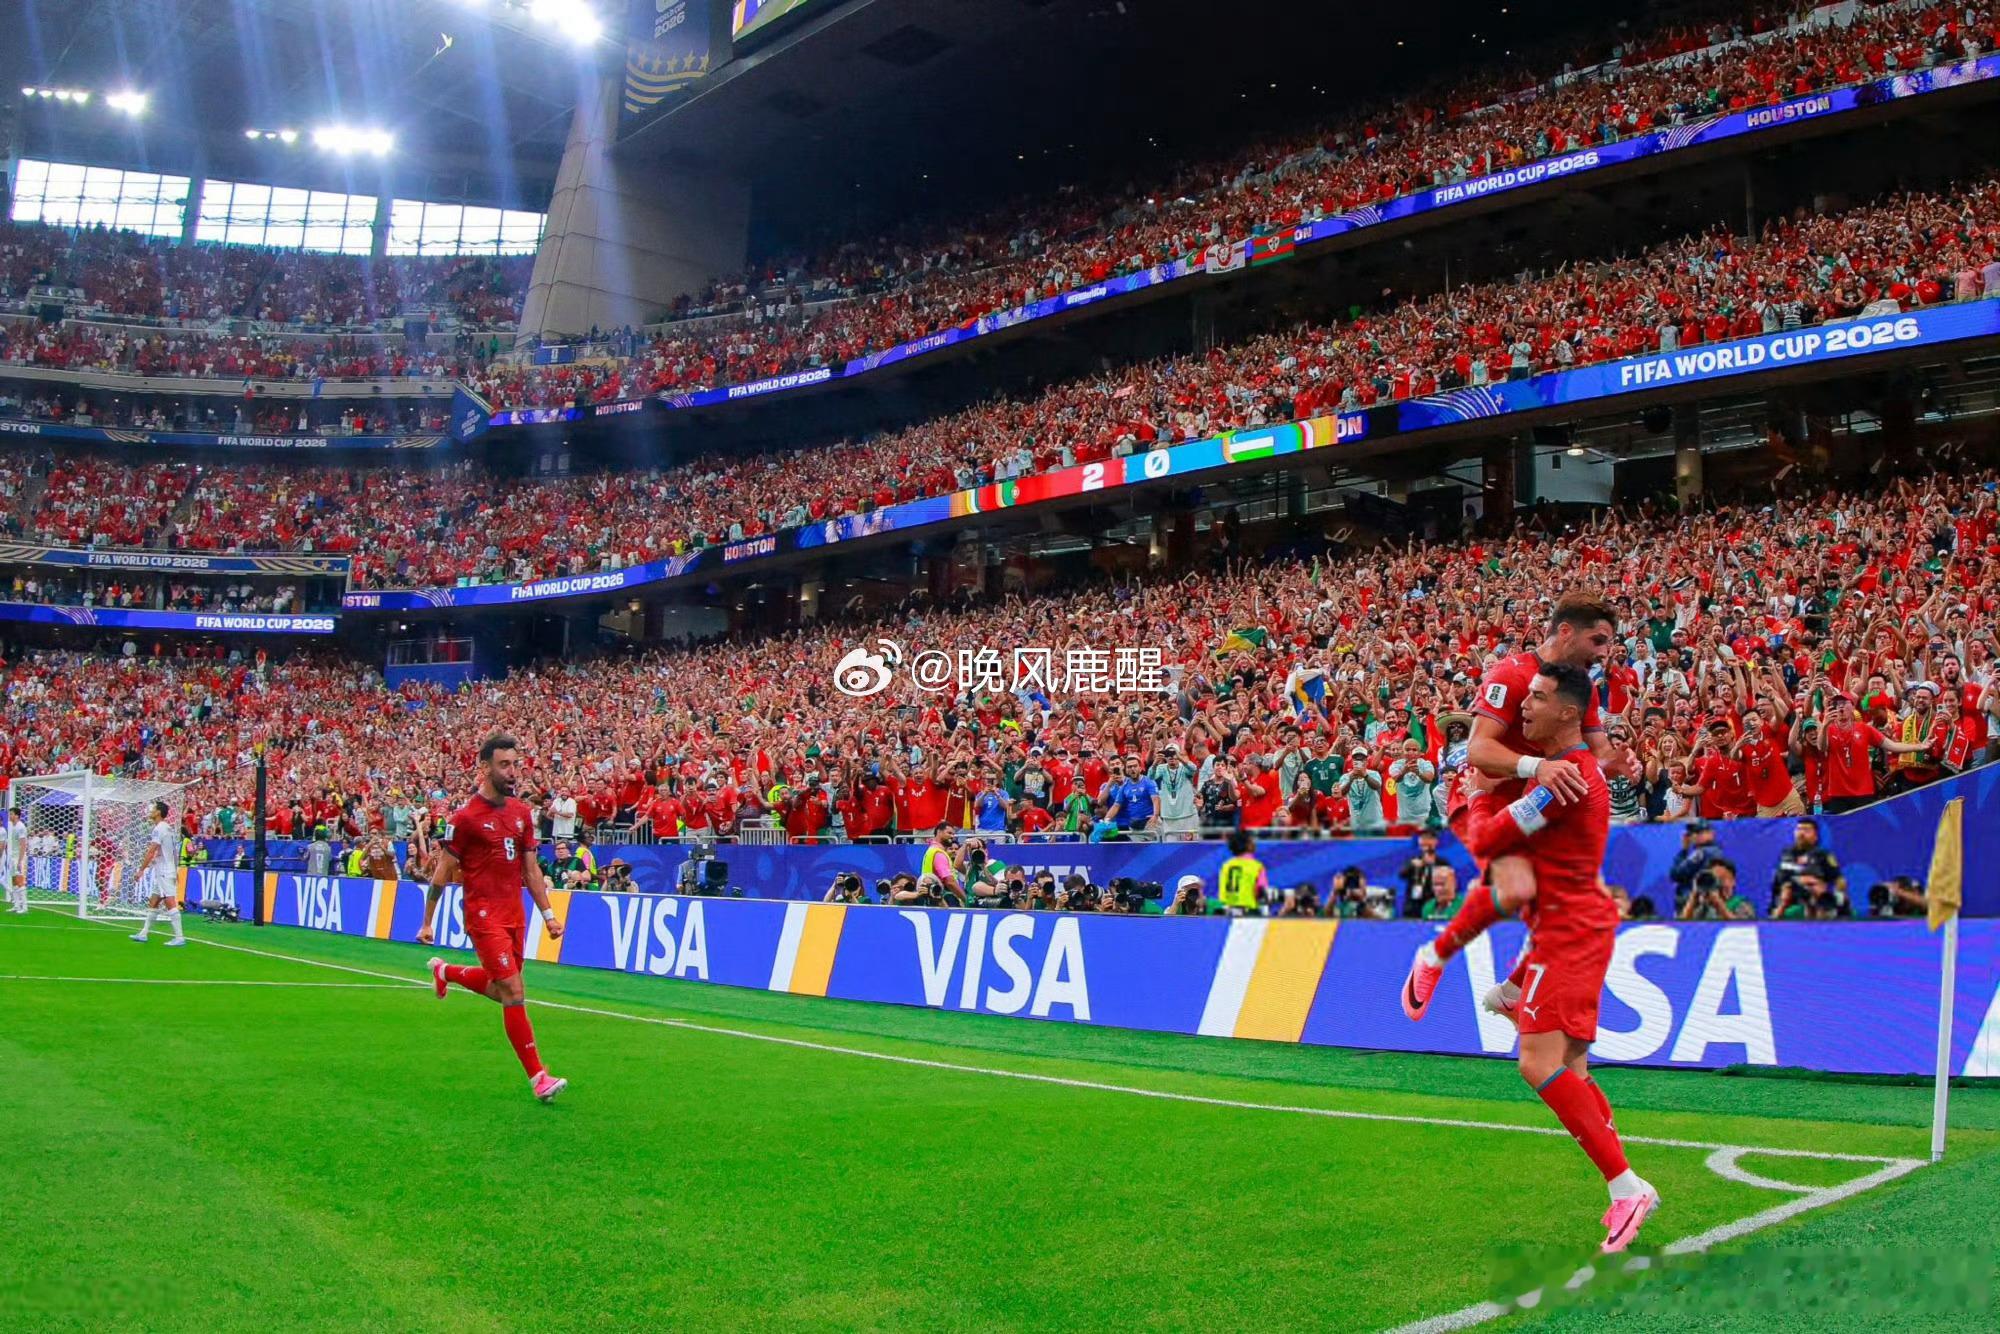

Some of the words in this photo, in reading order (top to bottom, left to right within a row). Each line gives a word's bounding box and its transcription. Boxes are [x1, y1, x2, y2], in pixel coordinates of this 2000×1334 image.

[655, 11, 685, 38] 2026
[1747, 98, 1829, 127] HOUSTON
[1435, 187, 1464, 204] FIFA
[1466, 173, 1515, 196] WORLD
[1518, 165, 1545, 187] CUP
[1547, 151, 1599, 176] 2026
[906, 333, 948, 356] HOUSTON
[1621, 361, 1673, 387] FIFA
[1674, 343, 1766, 378] WORLD
[1769, 333, 1821, 362] CUP
[1826, 318, 1918, 352] 2026
[729, 386, 748, 399] FIFA
[748, 379, 779, 395] WORLD
[780, 375, 798, 388] CUP
[799, 368, 831, 384] 2026
[596, 401, 642, 416] HOUSTON
[218, 436, 239, 447] FIFA
[239, 437, 274, 448] WORLD
[274, 438, 293, 448] CUP
[295, 438, 327, 448] 2026
[1082, 462, 1105, 491] 2
[1144, 449, 1170, 478] 0
[88, 554, 111, 566] FIFA
[111, 555, 149, 566] WORLD
[150, 557, 171, 567] CUP
[172, 558, 209, 568] 2026
[724, 537, 776, 560] HOUSTON
[534, 580, 569, 597] WORLD
[570, 577, 591, 593] CUP
[592, 572, 623, 589] 2026
[196, 616, 222, 629] FIFA
[223, 617, 265, 630] WORLD
[266, 618, 291, 630] CUP
[291, 619, 334, 631] 2026
[199, 870, 235, 909] VISA
[292, 875, 342, 932] VISA
[417, 884, 474, 949] VIS
[602, 894, 709, 980] VISA
[900, 910, 1091, 1021] VISA
[1527, 962, 1548, 1003] 7
[1436, 924, 1778, 1065] VSA
